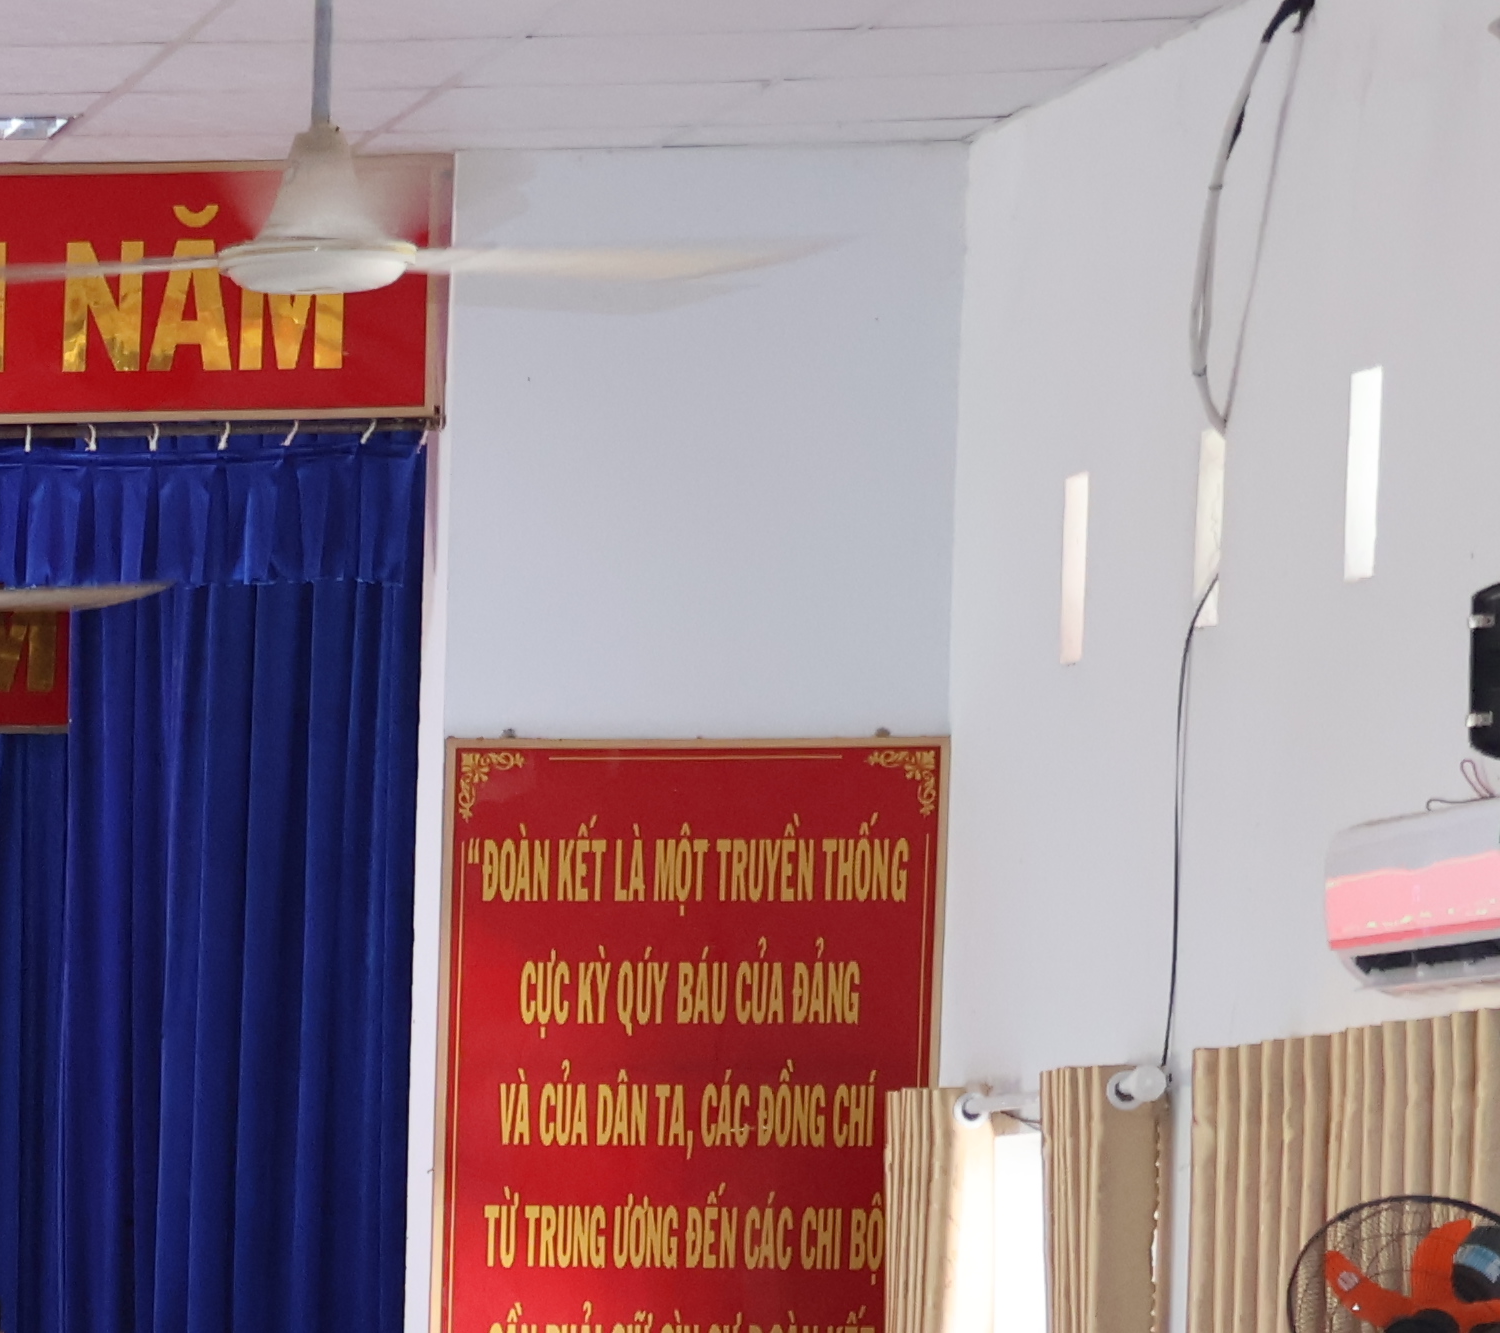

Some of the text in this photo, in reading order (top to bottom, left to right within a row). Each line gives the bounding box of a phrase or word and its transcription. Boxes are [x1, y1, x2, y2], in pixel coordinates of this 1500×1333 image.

[62, 204, 345, 372] NĂM
[558, 815, 606, 901] KẾT
[615, 824, 645, 901] LÀ
[654, 822, 710, 916] MỘT
[717, 813, 814, 902] TRUYỀN
[822, 812, 909, 902] THỐNG
[521, 949, 569, 1039] CỰC
[578, 945, 611, 1024] KỲ
[677, 946, 727, 1024] BÁU
[736, 936, 783, 1024] CỦA
[792, 937, 860, 1024] ĐẢNG
[500, 1059, 876, 1159] VÀ CỦA DÂN TA, CÁC ĐỒNG CHÍ
[485, 1183, 882, 1285] TỪ TRUNG ƯƠNG ĐẾN CÁC CHI BỘ
